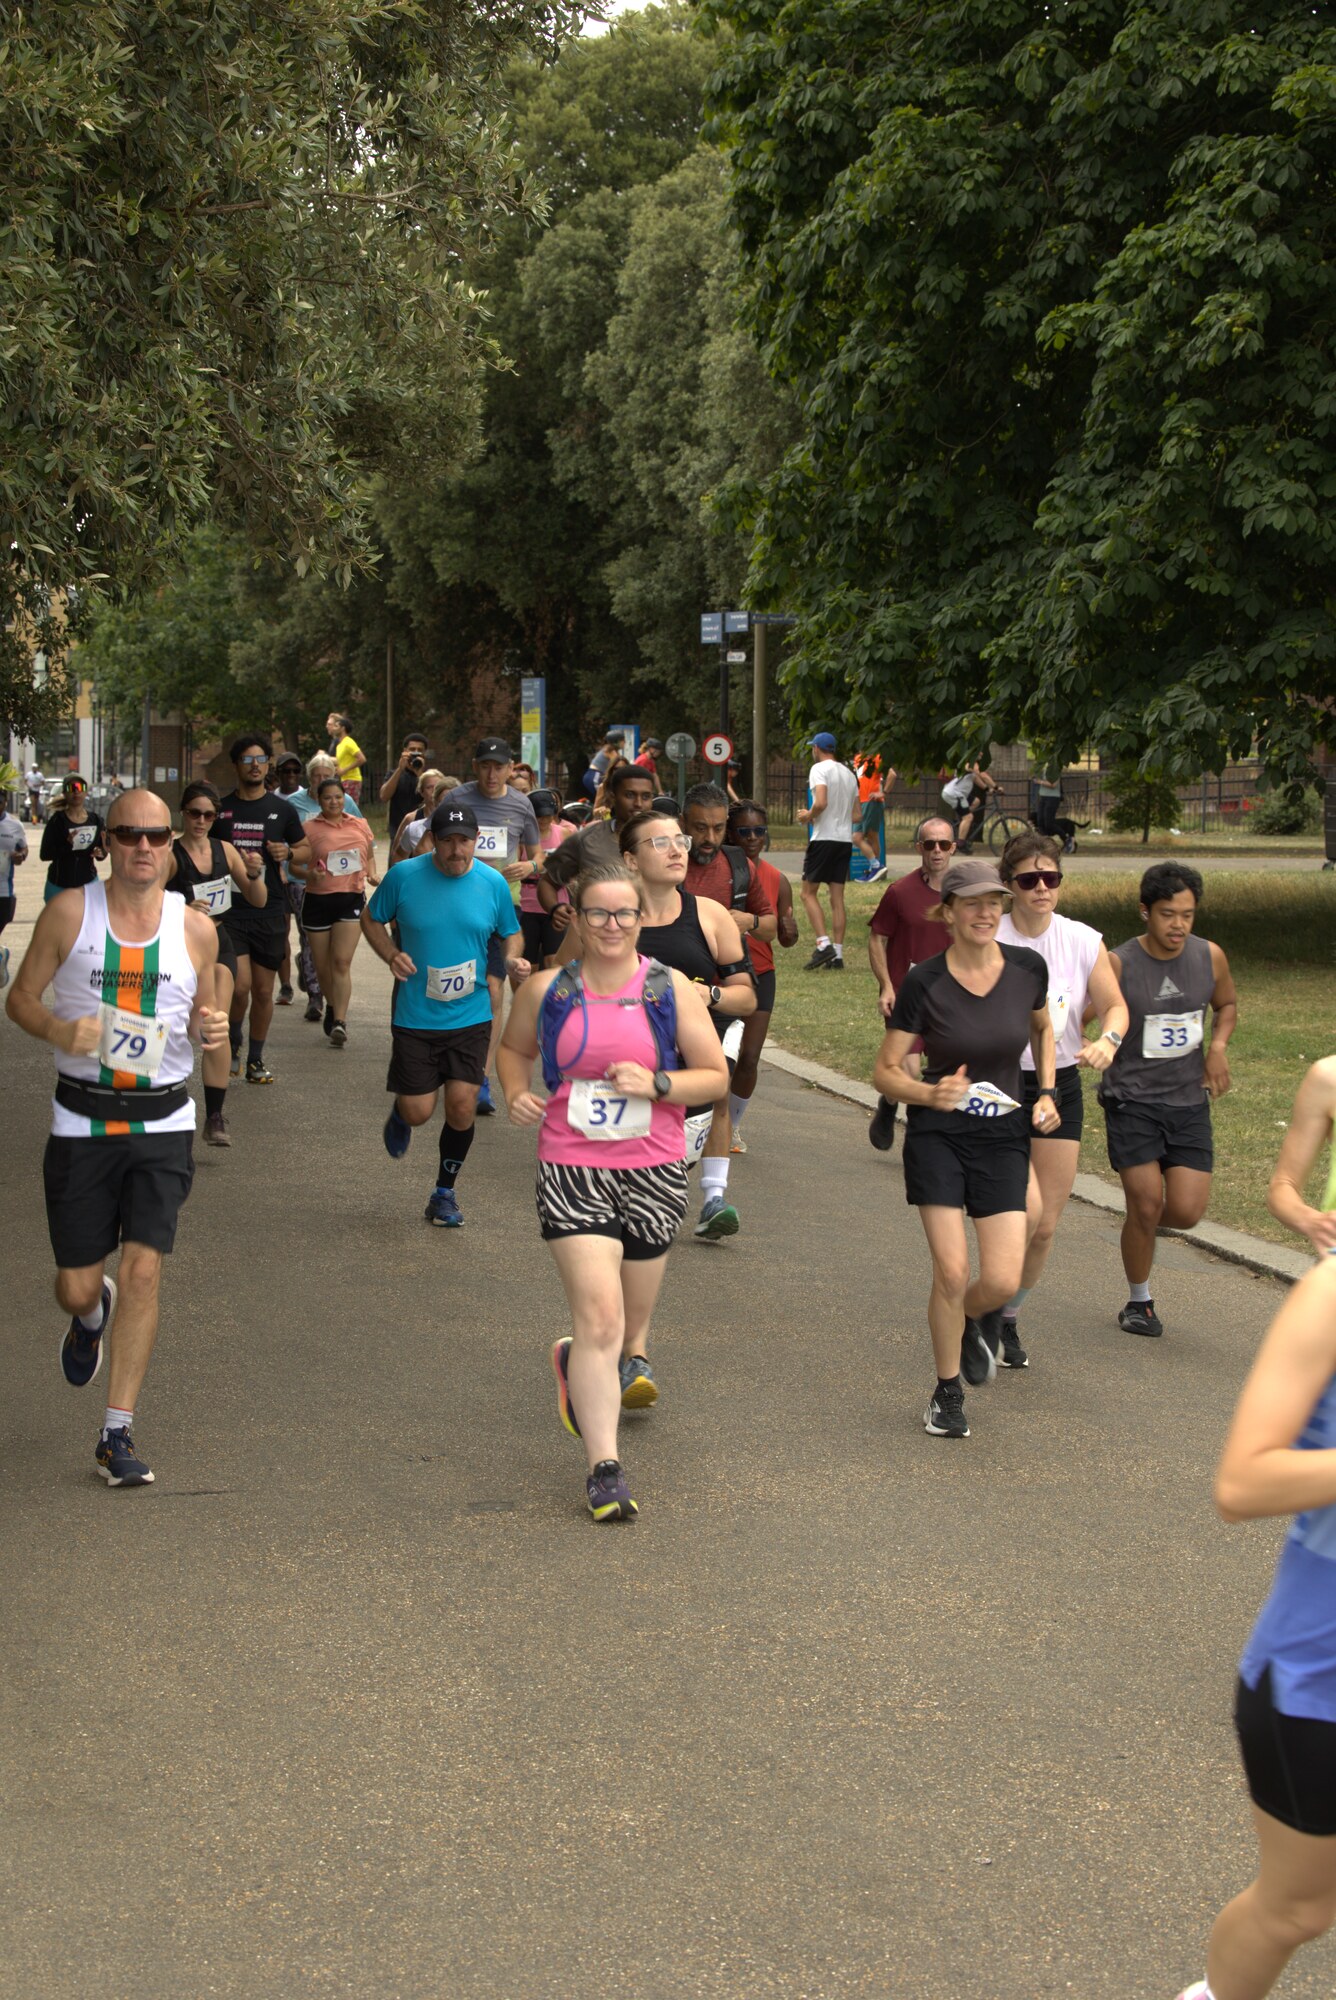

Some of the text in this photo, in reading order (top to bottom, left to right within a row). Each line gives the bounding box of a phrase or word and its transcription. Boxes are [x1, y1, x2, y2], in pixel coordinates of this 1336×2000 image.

[714, 744, 722, 755] 5
[79, 833, 92, 844] 32
[478, 836, 496, 849] 26
[340, 858, 348, 869] 9
[207, 889, 225, 907] 77
[91, 968, 171, 982] MORNINGTON
[90, 979, 143, 989] CHASERS
[441, 976, 464, 993] 70
[111, 1028, 146, 1059] 79
[1161, 1027, 1188, 1047] 33
[589, 1098, 628, 1125] 37
